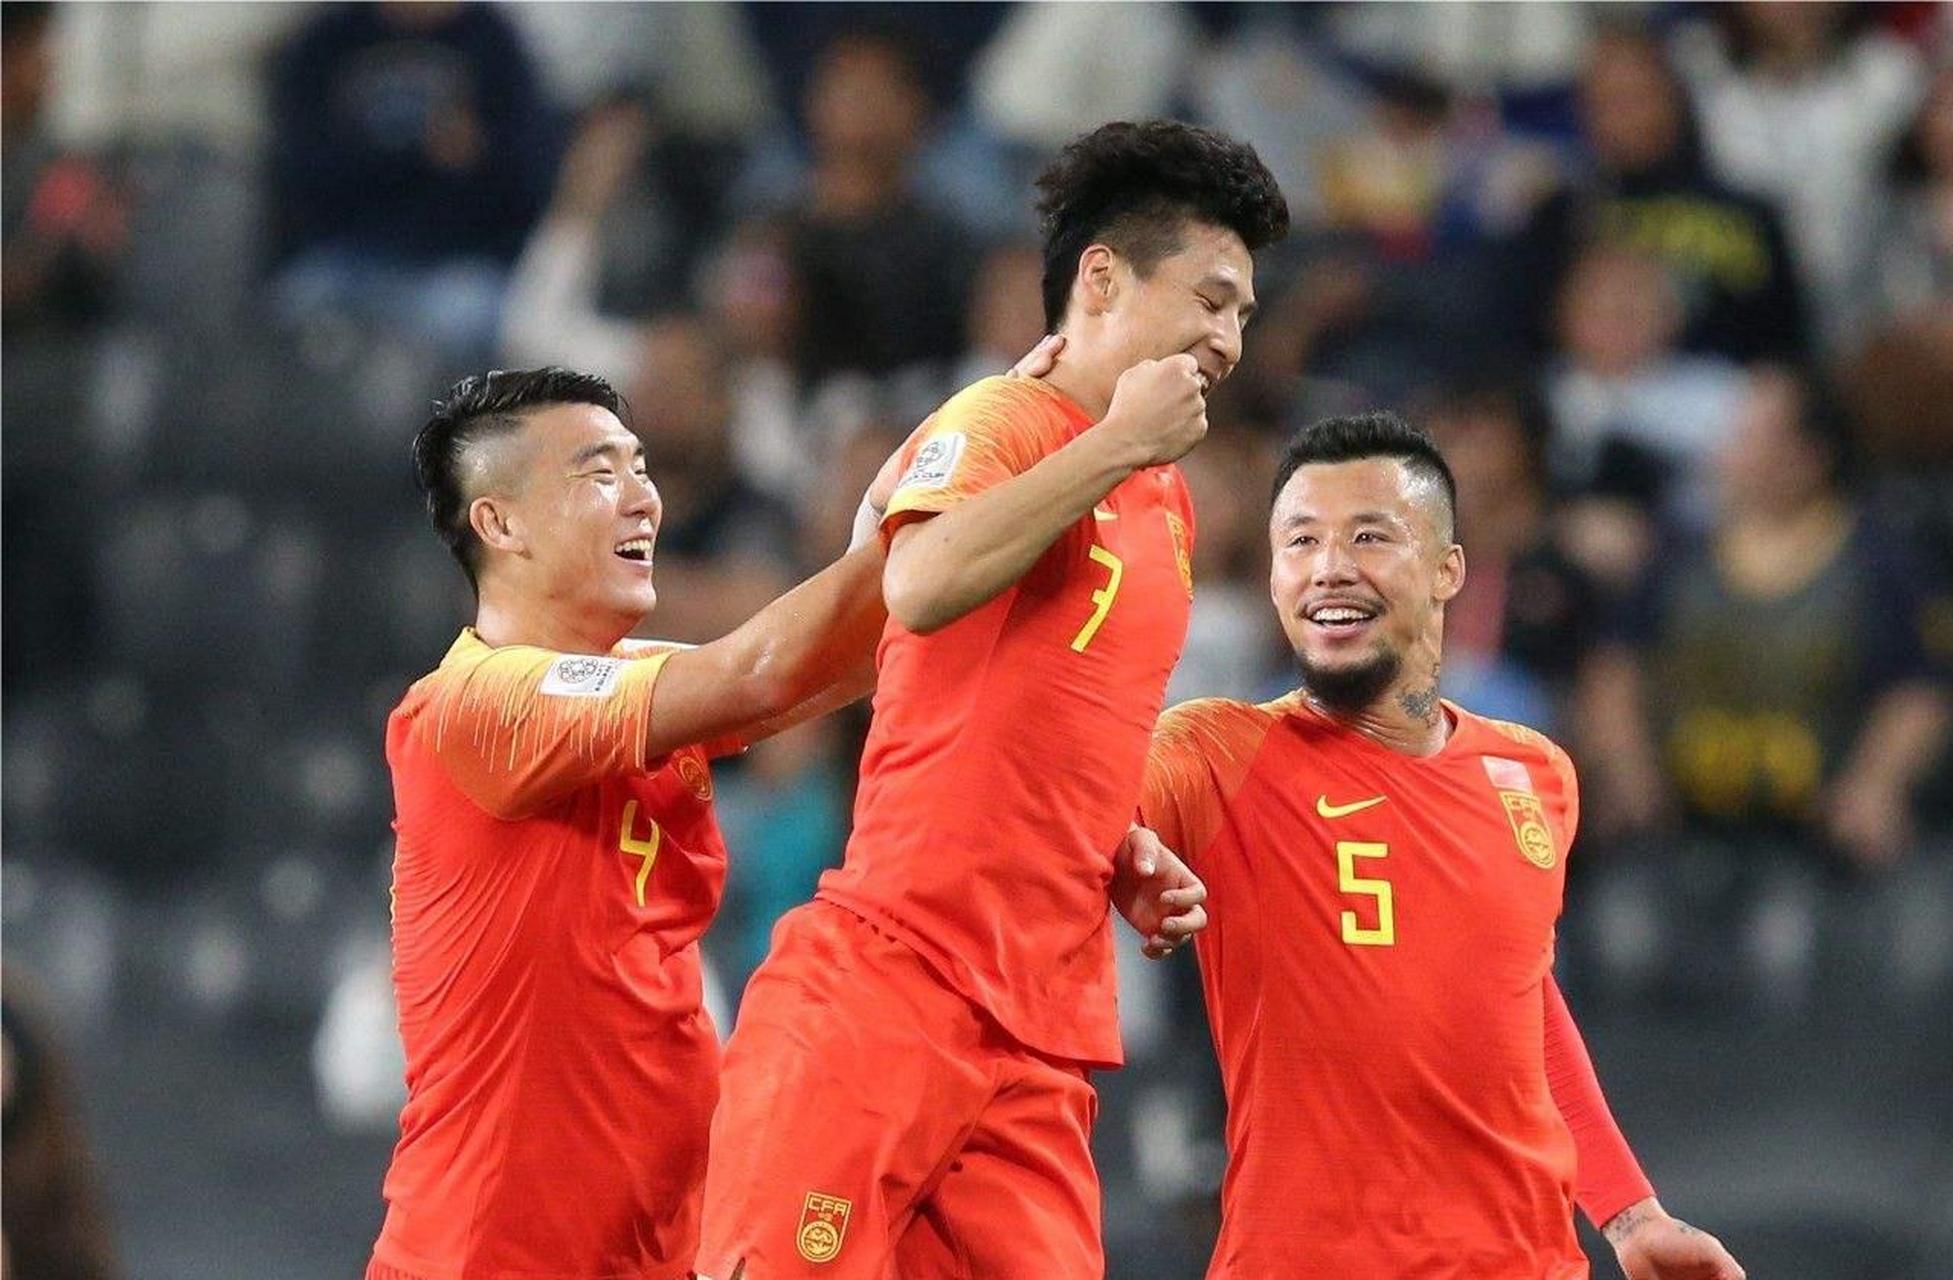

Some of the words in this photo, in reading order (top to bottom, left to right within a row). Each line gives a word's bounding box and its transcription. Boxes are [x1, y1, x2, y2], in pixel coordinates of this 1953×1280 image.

[1070, 544, 1124, 653] 7
[620, 799, 660, 908] 4
[1336, 841, 1395, 946] 5
[809, 1197, 847, 1217] CFA
